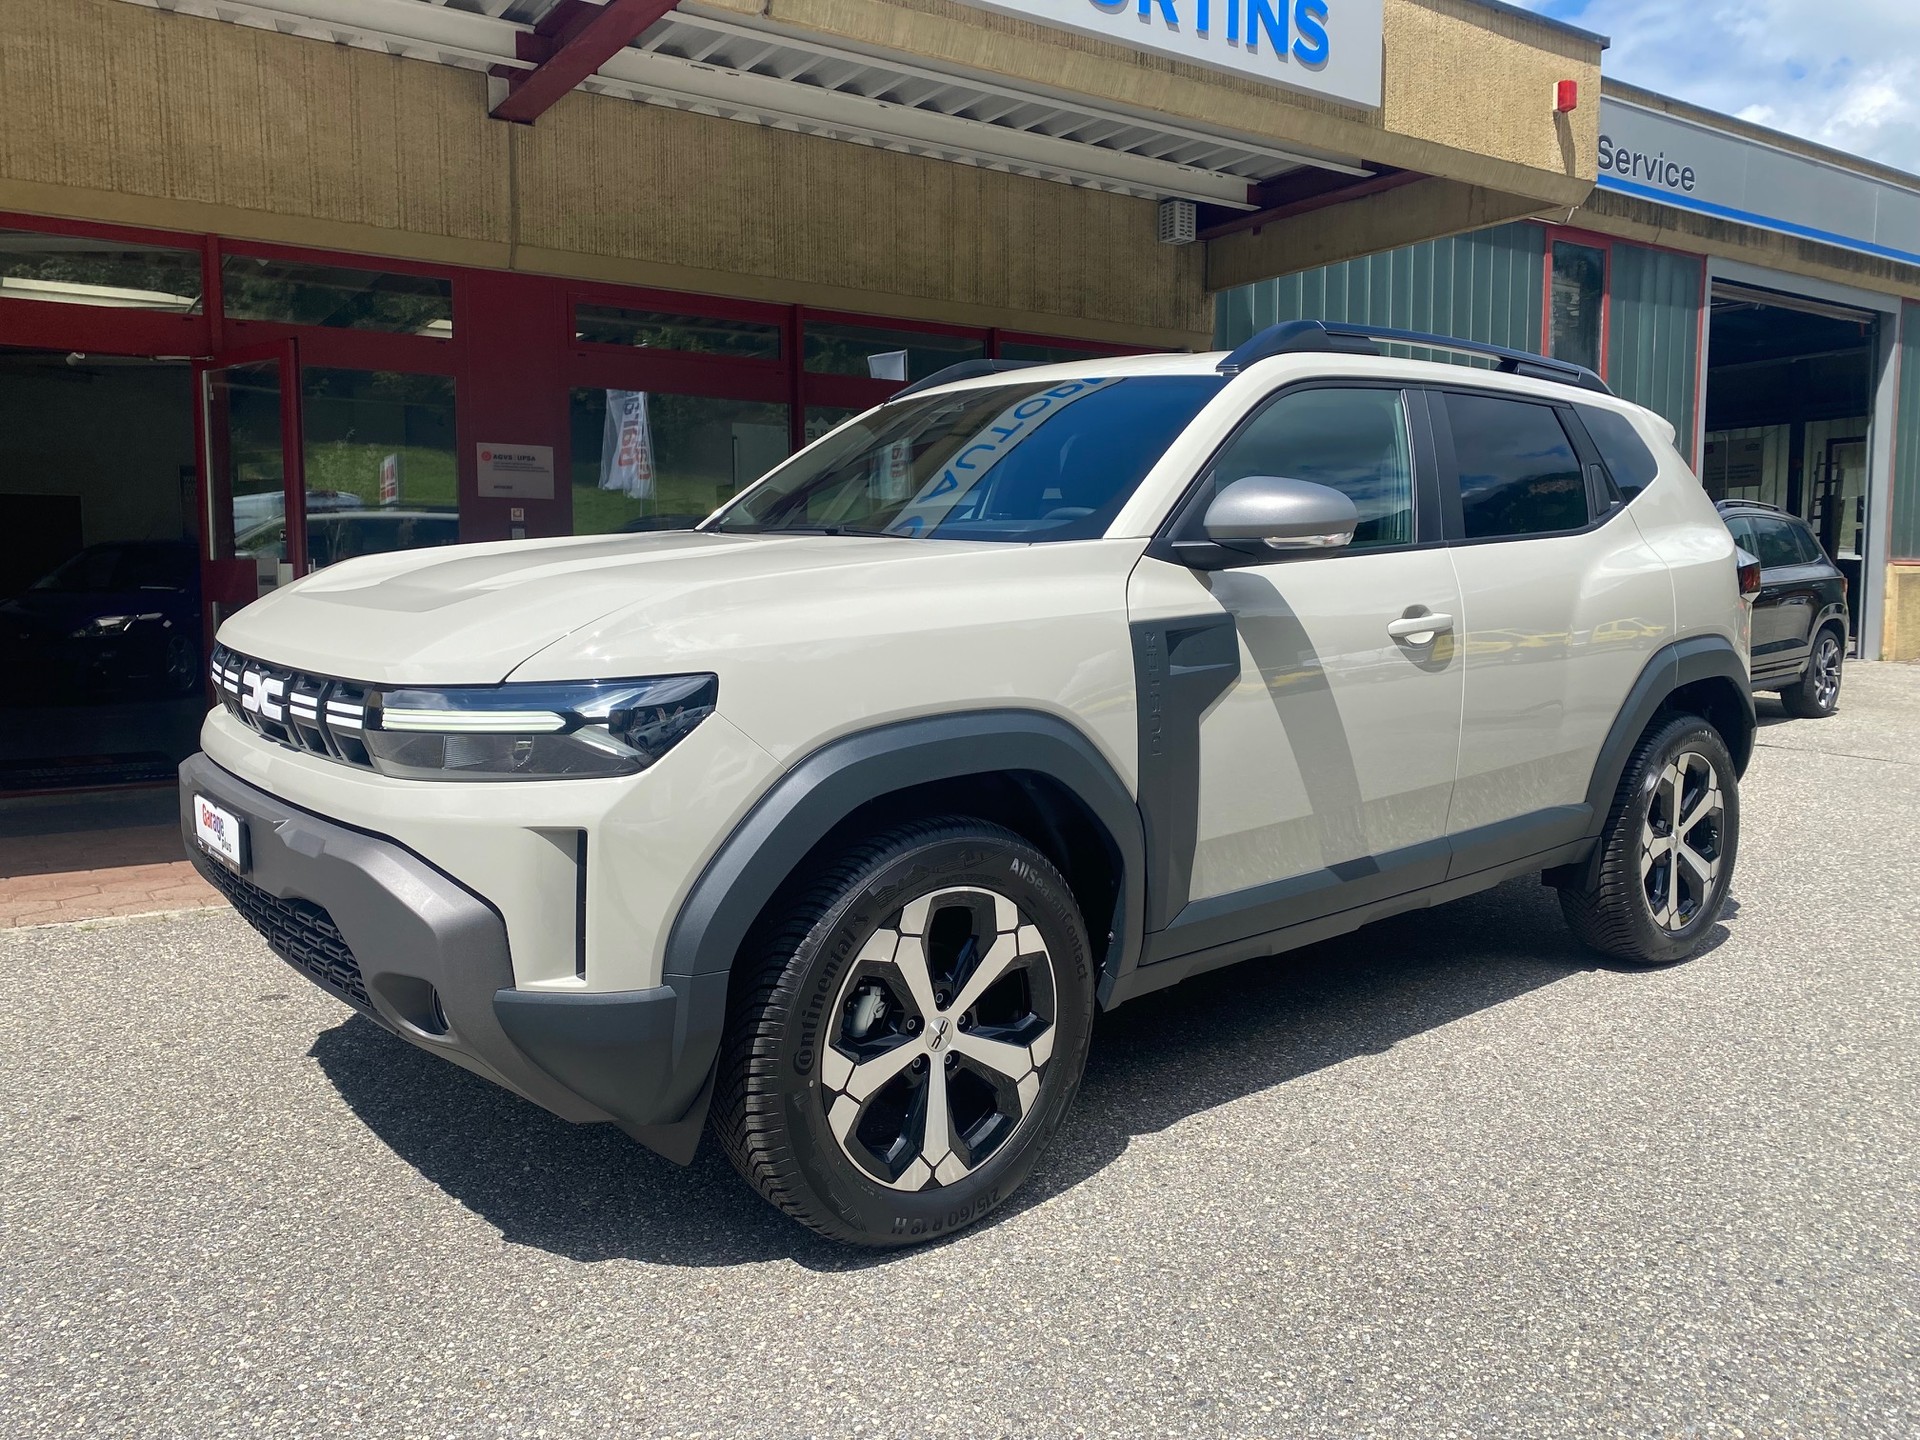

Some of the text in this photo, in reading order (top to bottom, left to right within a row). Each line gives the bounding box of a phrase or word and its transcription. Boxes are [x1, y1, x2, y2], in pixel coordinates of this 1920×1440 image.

[1597, 134, 1696, 192] Service
[1145, 631, 1162, 756] DUSTER
[202, 803, 225, 841] Garage
[792, 929, 858, 1076] Continental
